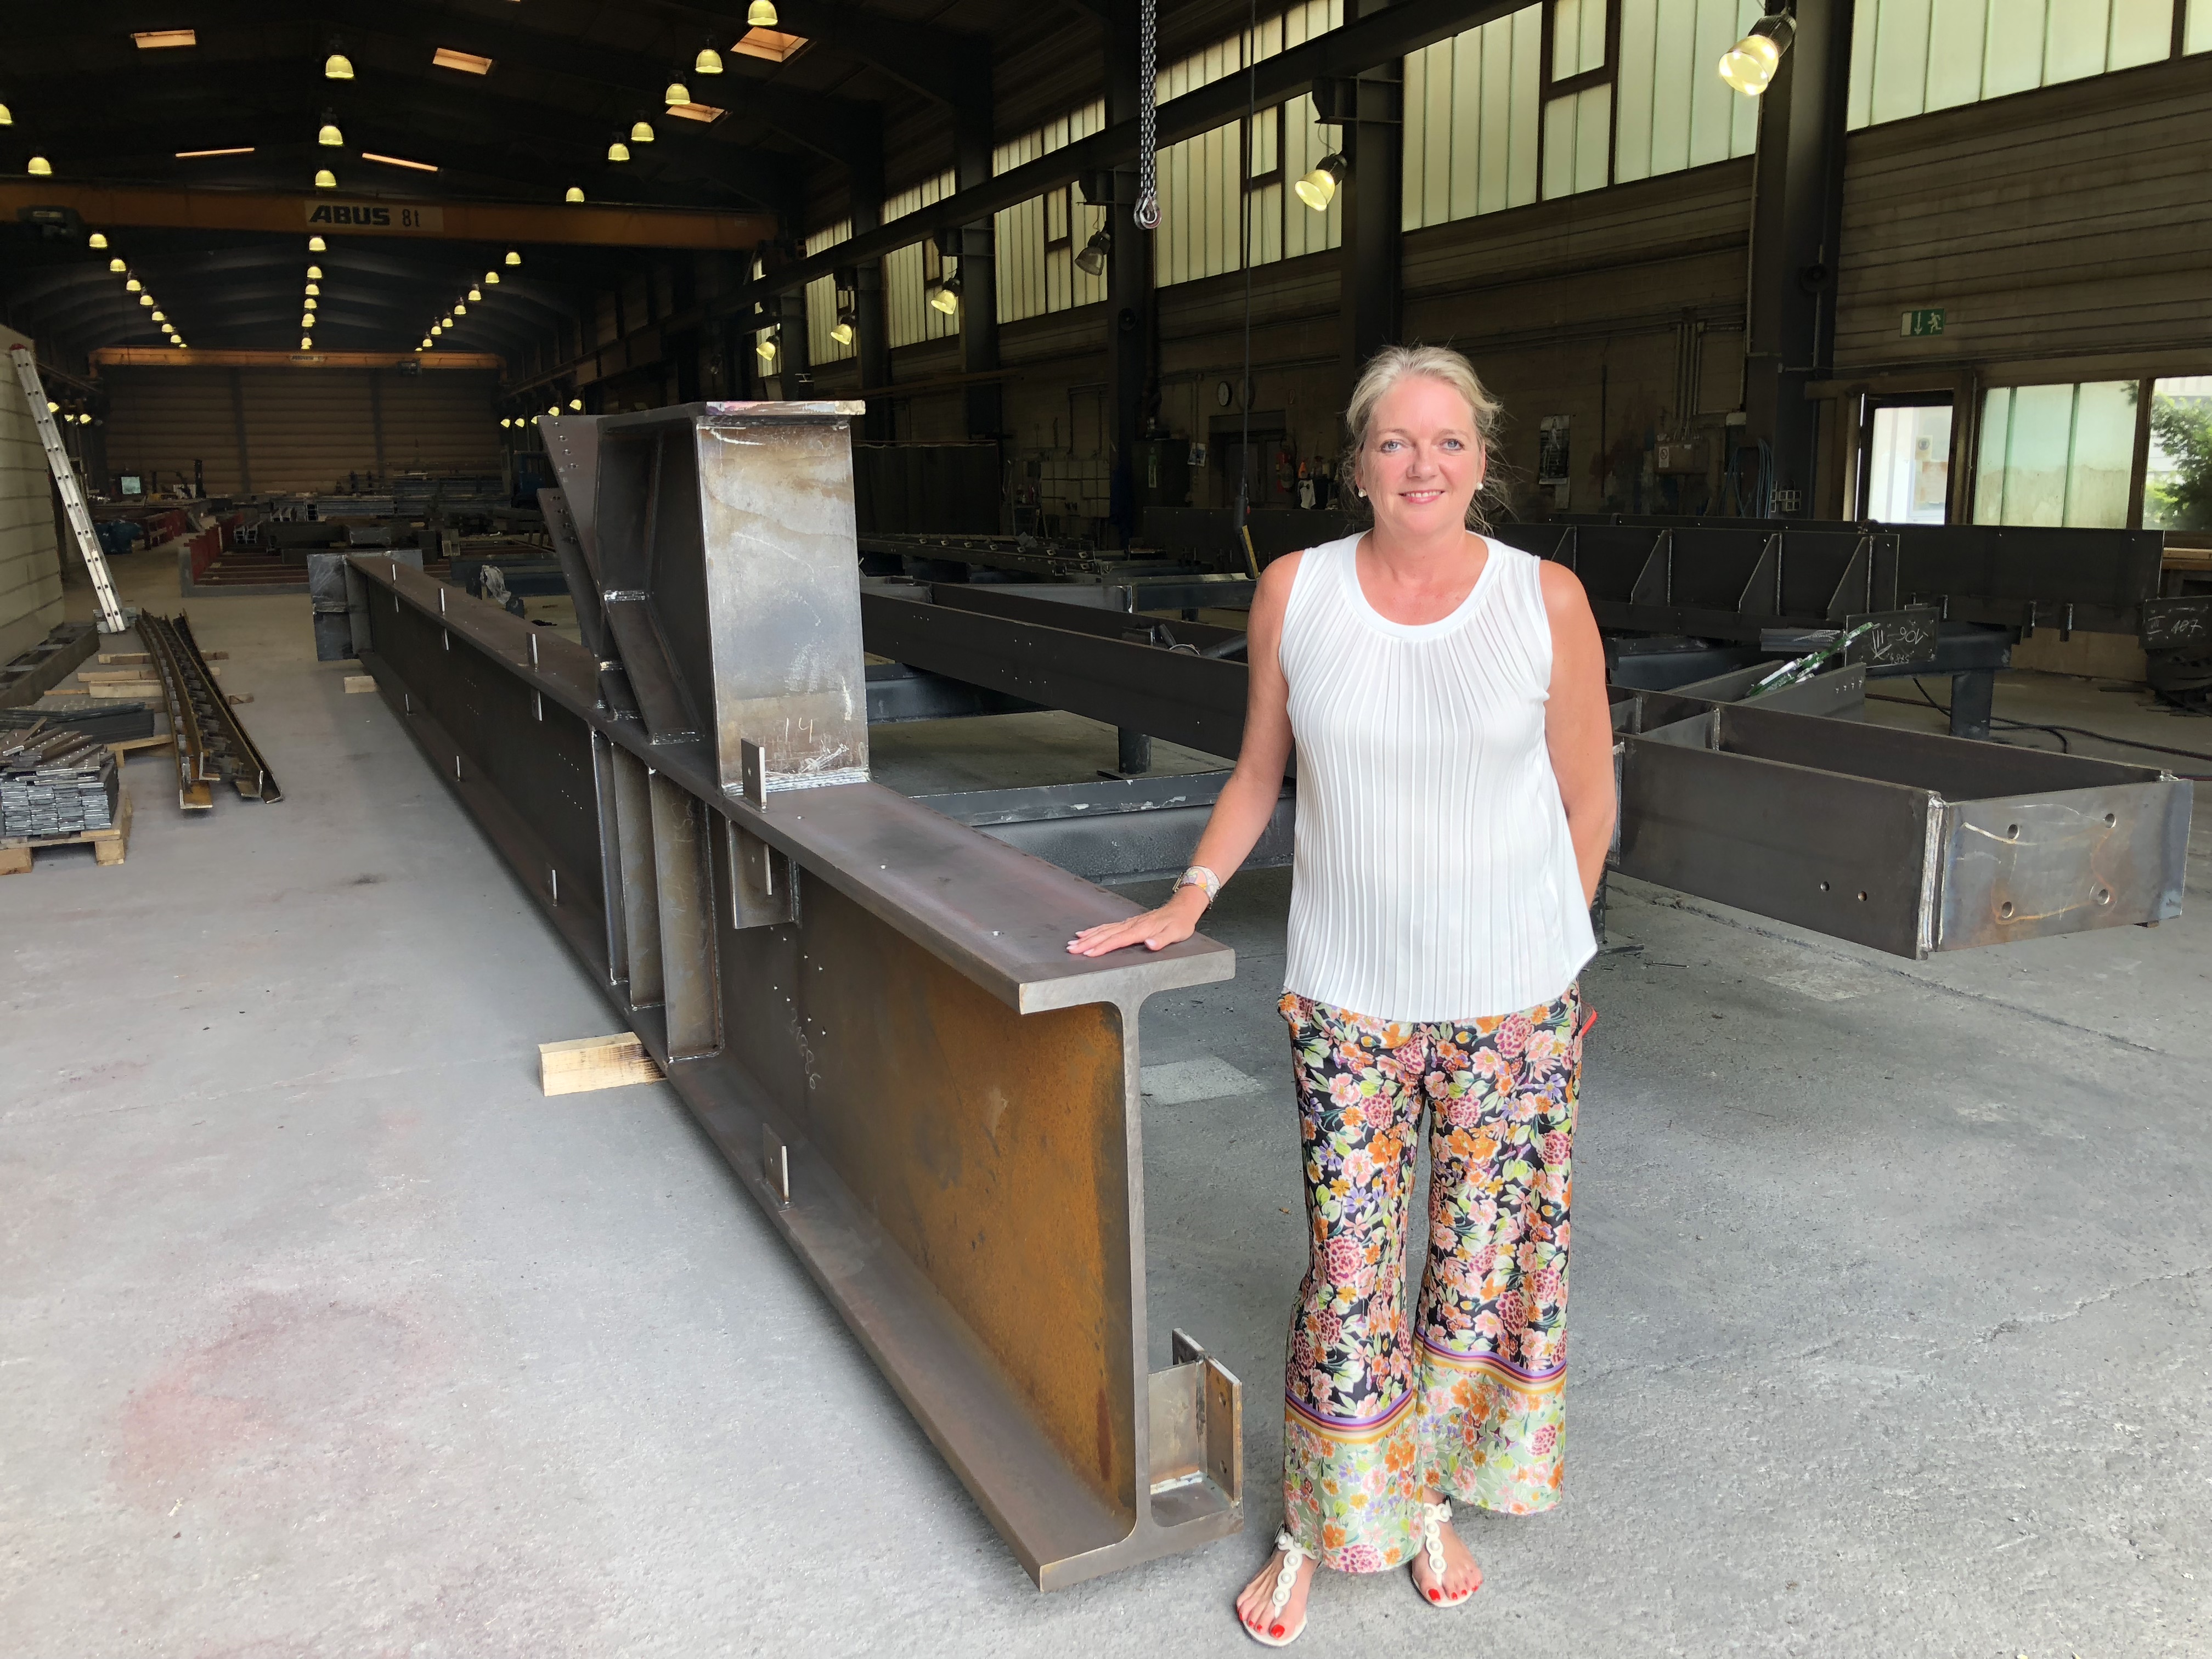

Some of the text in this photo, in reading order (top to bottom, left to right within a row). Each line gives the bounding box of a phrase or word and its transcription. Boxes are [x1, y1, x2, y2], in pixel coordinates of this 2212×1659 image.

[309, 205, 391, 225] ABUS
[1896, 627, 1925, 645] 106
[785, 716, 813, 744] 14
